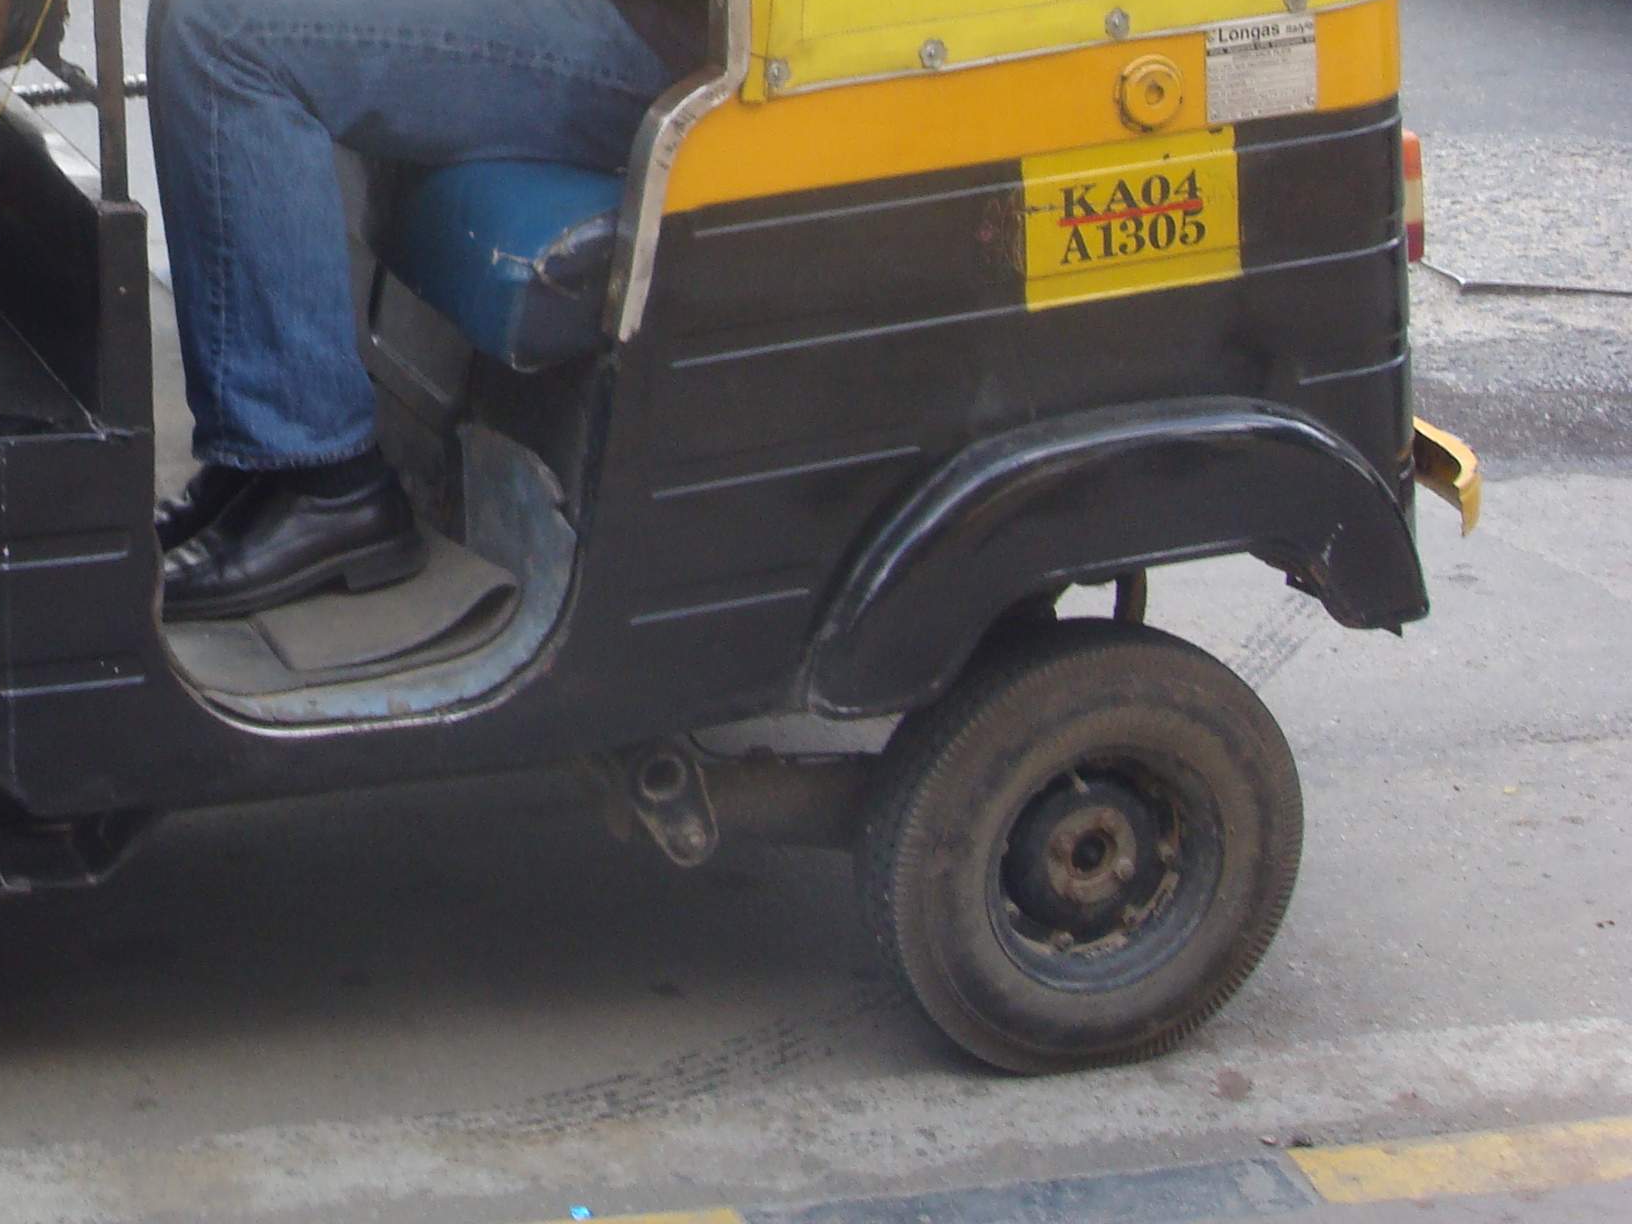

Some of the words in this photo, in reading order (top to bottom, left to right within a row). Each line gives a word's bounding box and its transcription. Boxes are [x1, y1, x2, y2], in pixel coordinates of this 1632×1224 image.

[1218, 24, 1280, 42] Longas
[1059, 169, 1202, 221] KA04
[1060, 207, 1207, 264] A1305
